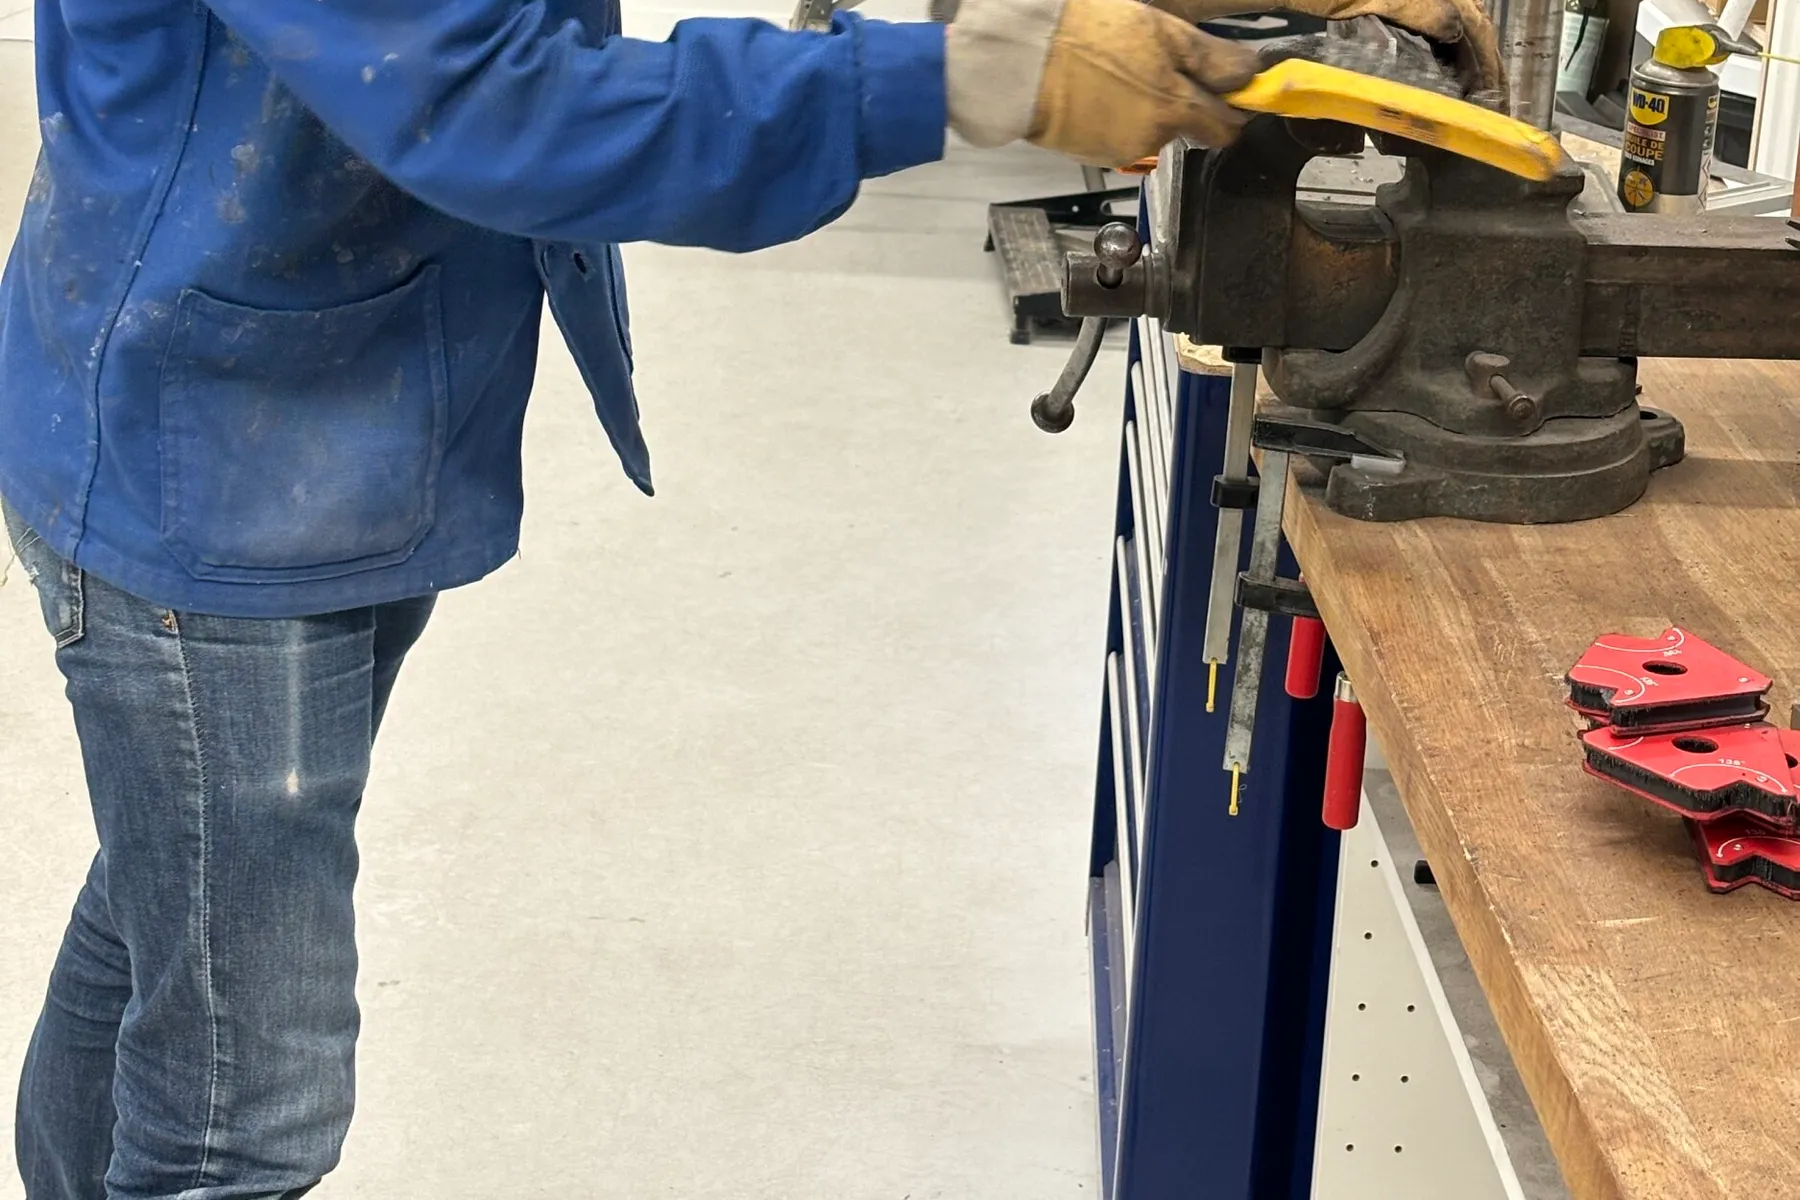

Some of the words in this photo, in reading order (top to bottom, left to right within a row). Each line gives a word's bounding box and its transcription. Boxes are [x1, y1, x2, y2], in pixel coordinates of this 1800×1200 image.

[1632, 91, 1665, 113] WD-40
[1624, 142, 1664, 160] COUPE
[1650, 140, 1665, 150] DE
